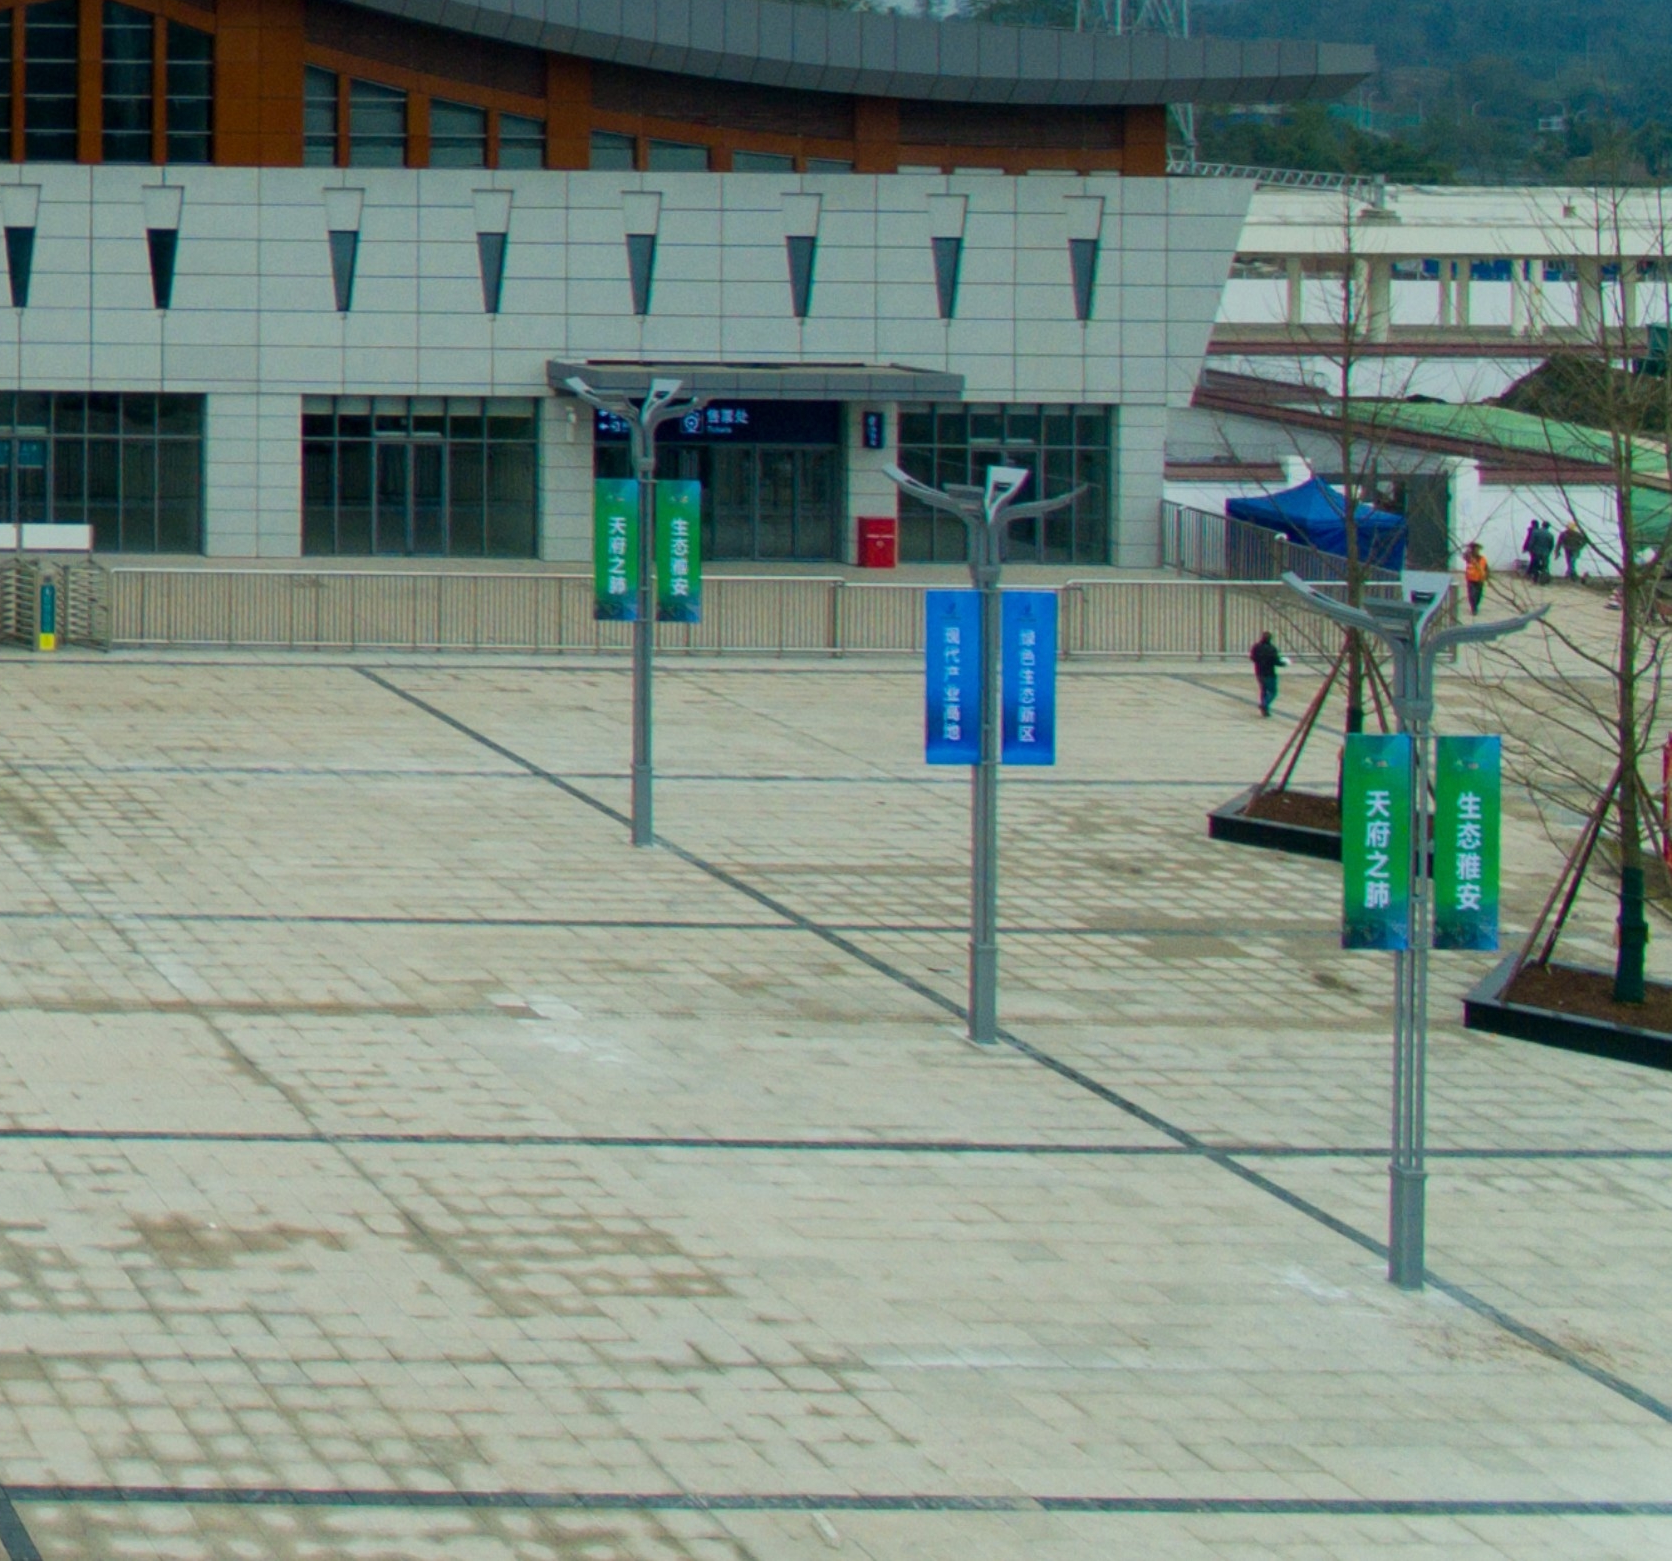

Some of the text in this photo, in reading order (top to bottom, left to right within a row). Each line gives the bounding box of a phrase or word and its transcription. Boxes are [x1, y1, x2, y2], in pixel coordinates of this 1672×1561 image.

[707, 407, 749, 425] 售票处
[670, 517, 689, 596] 生态雅安
[1364, 789, 1392, 910] 天府之肺
[1455, 790, 1483, 911] 生态雅安
